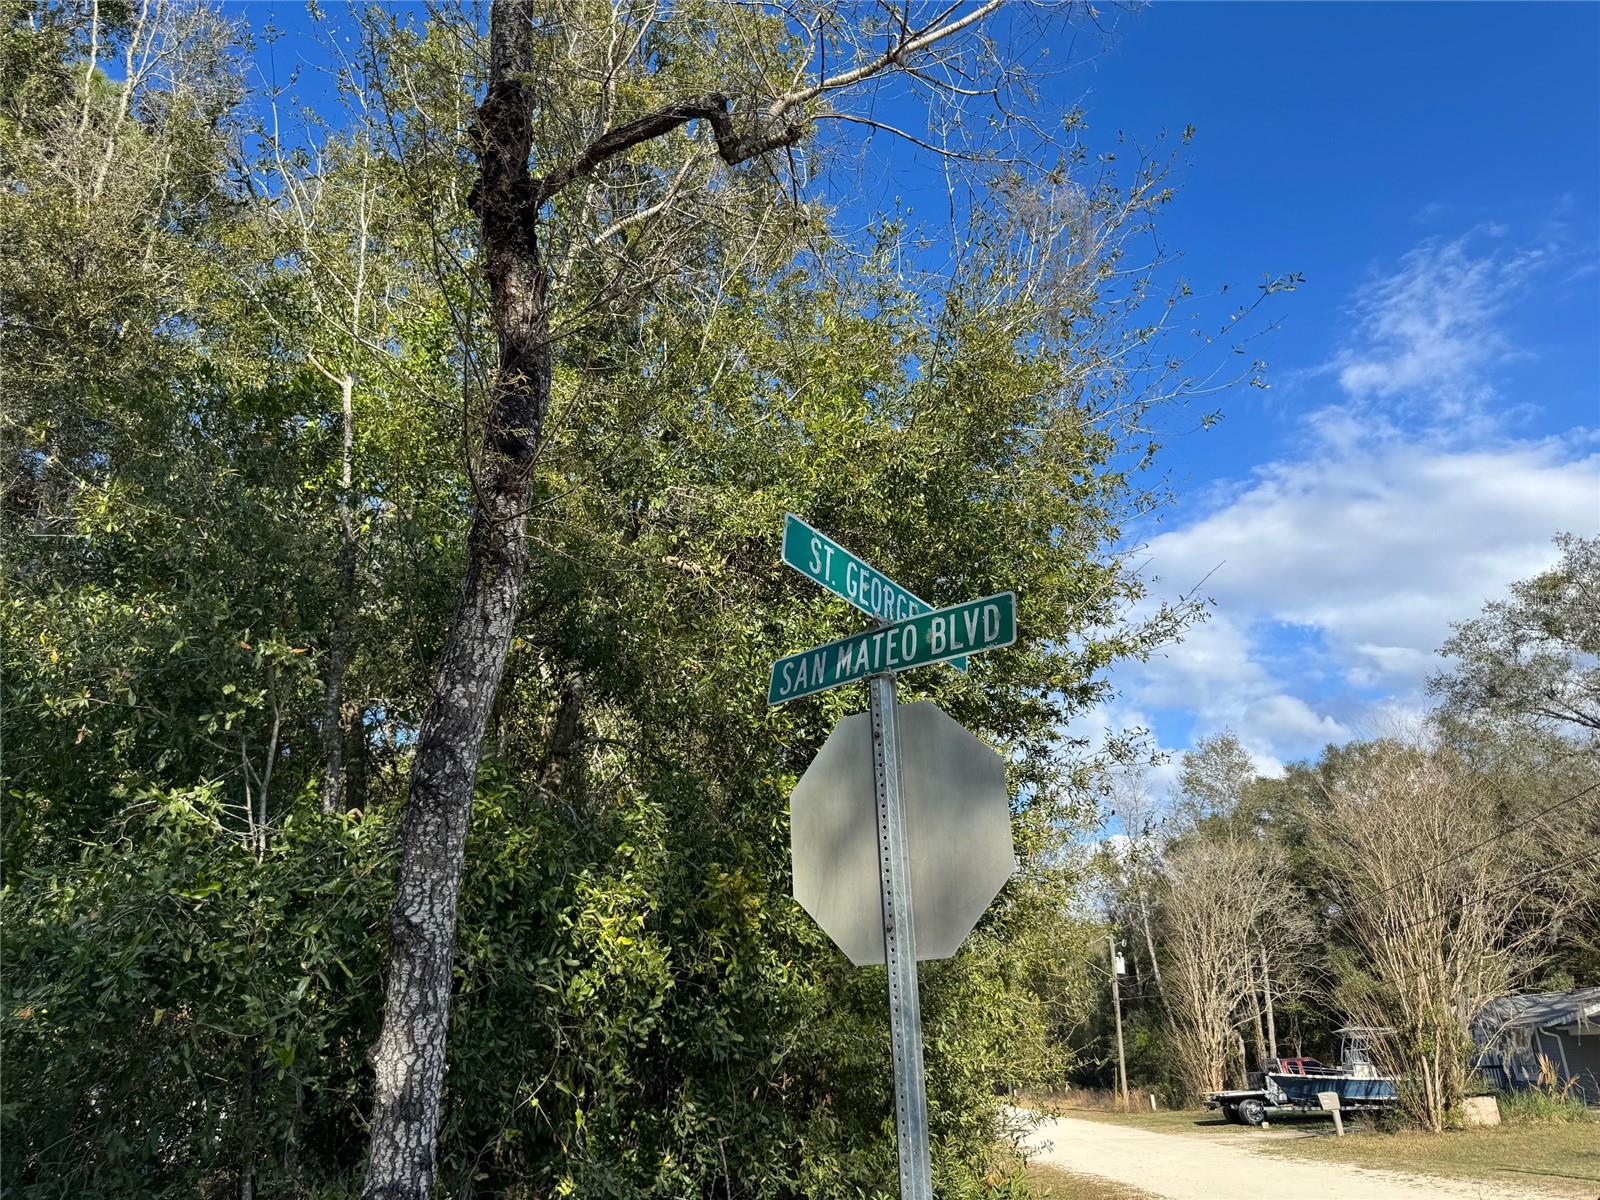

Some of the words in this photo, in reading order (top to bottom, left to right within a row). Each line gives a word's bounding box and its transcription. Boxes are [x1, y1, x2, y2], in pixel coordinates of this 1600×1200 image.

[809, 537, 836, 586] ST.
[779, 652, 827, 696] SAN
[835, 624, 917, 680] MATEO
[931, 604, 1000, 655] BLVD
